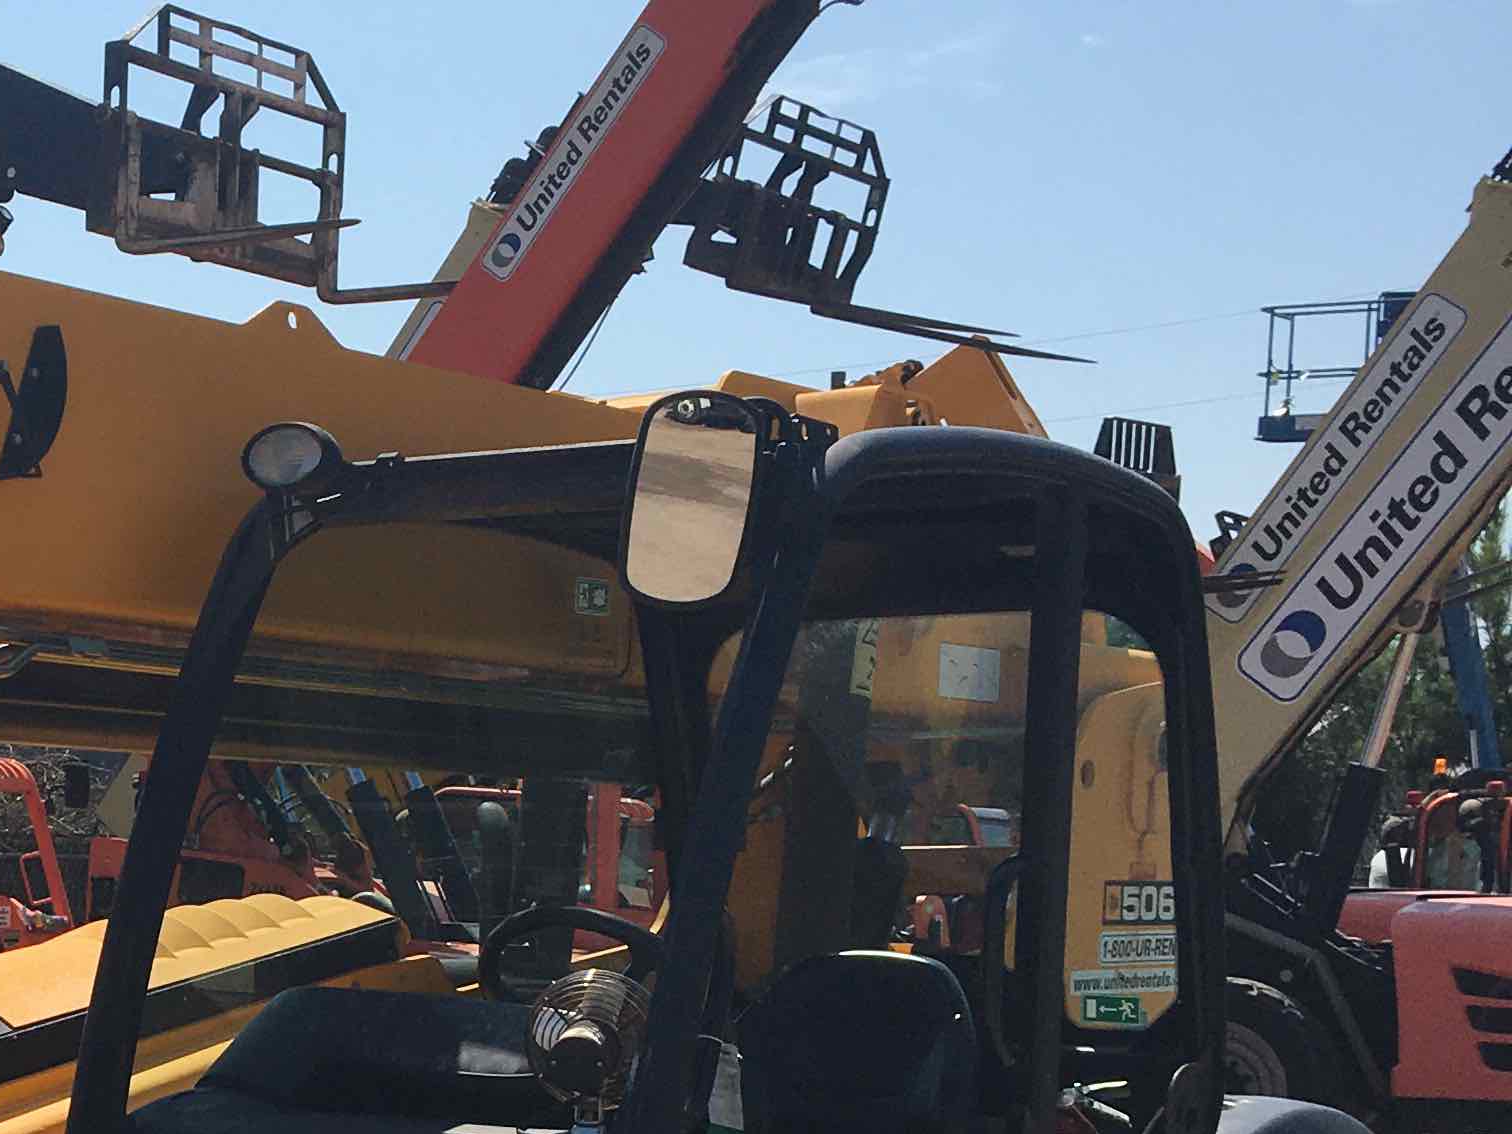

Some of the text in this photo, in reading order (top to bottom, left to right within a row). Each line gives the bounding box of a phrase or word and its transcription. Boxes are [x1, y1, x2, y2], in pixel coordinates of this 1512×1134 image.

[516, 42, 652, 232] United Rentals
[1251, 315, 1447, 561] United Rentals
[1315, 430, 1469, 610] United
[1122, 885, 1175, 921] 506
